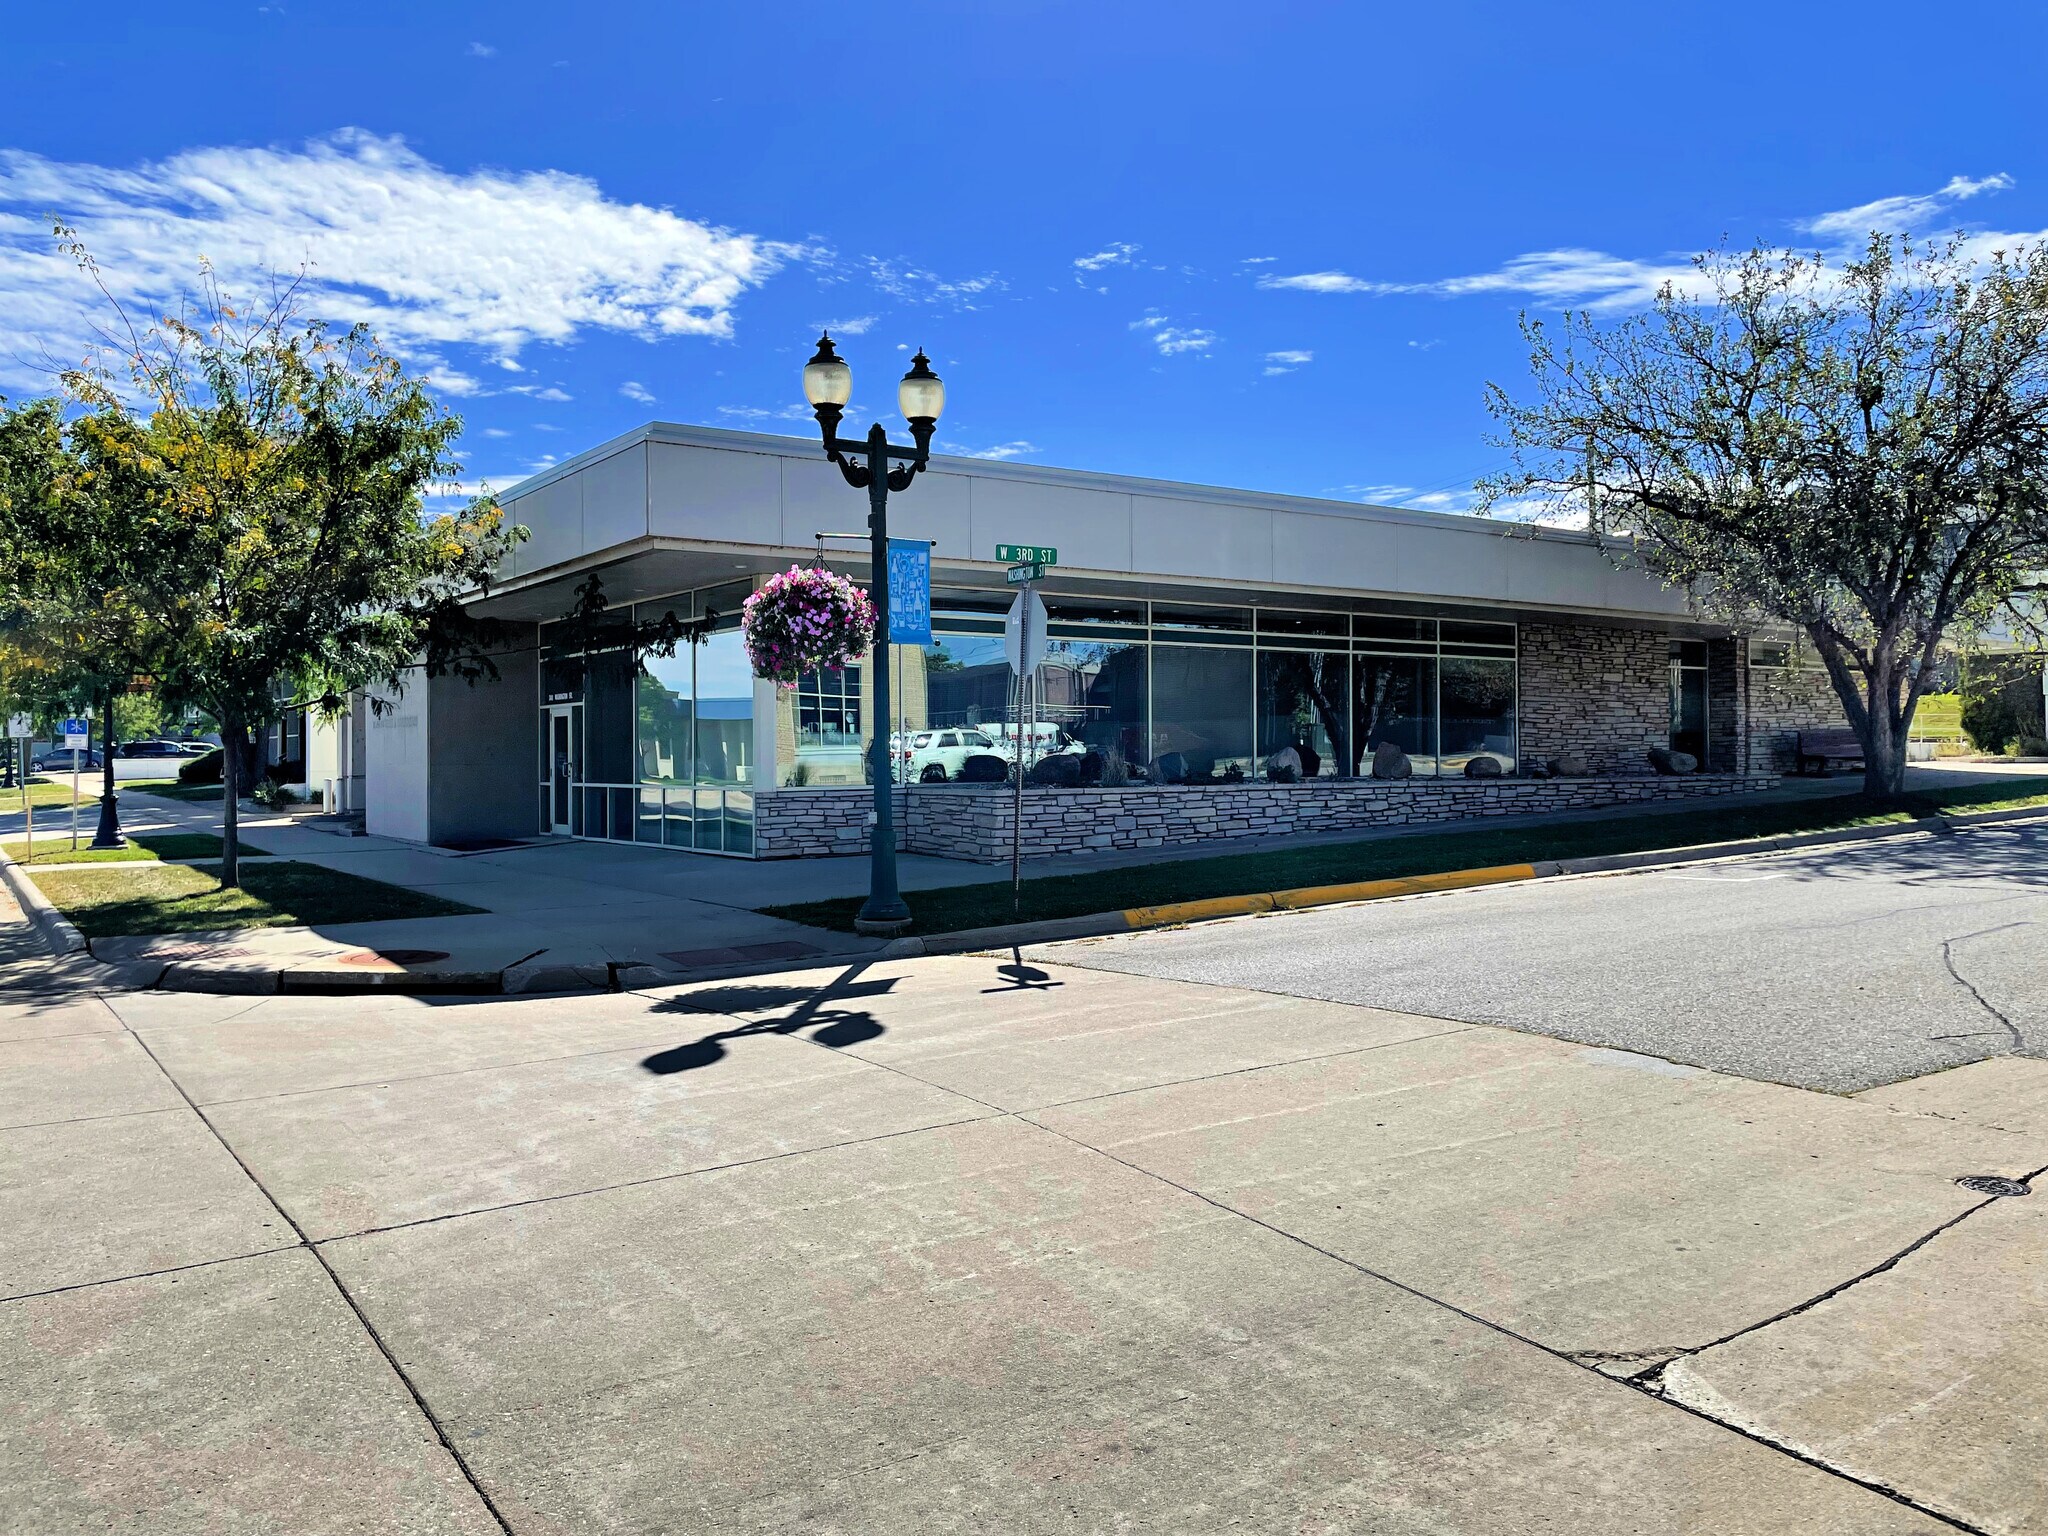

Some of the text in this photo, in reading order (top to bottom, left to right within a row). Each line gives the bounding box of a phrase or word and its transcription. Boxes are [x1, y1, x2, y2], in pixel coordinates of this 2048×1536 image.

[1000, 547, 1052, 562] W 3RD ST
